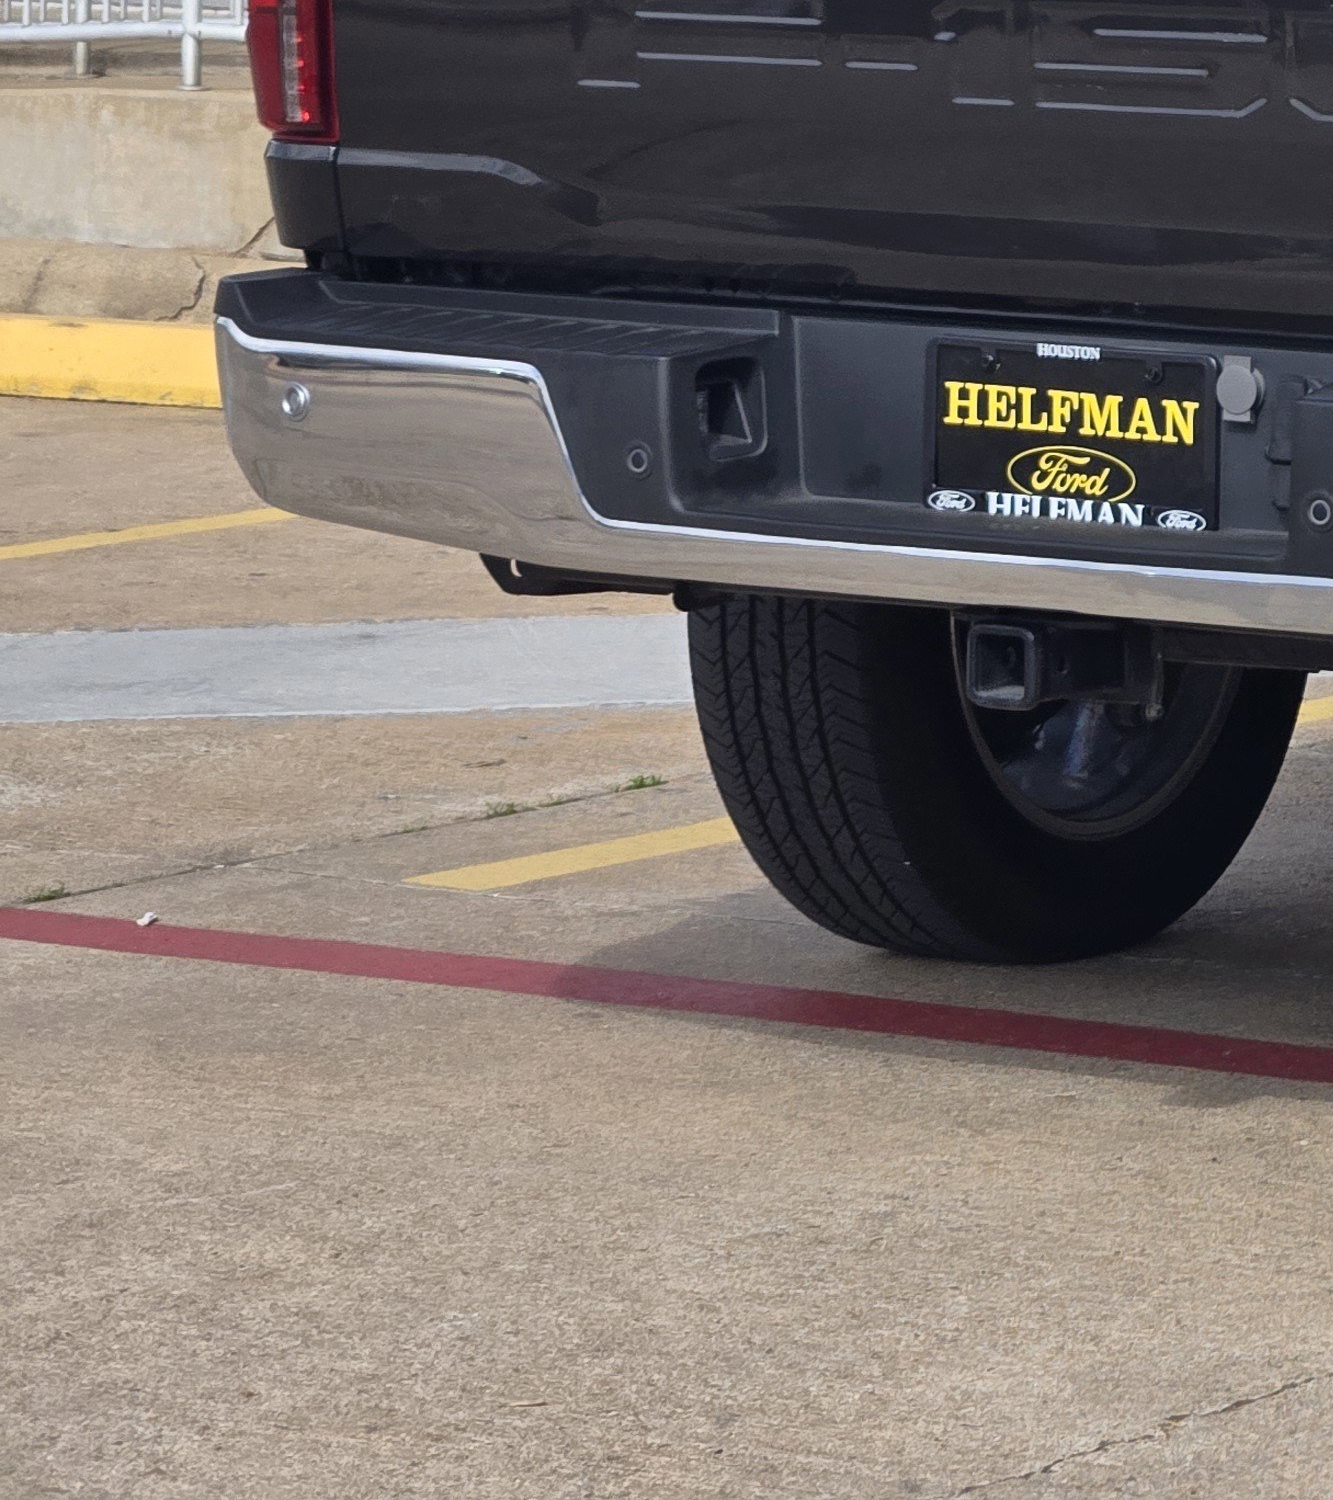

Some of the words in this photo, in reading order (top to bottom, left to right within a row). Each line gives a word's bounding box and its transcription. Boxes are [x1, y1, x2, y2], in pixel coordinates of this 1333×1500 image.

[1036, 342, 1101, 360] HOUSTON
[943, 380, 1200, 446] HELFMAN
[1030, 451, 1112, 497] Ford
[936, 491, 967, 510] Ford
[985, 490, 1146, 528] HELFMAN
